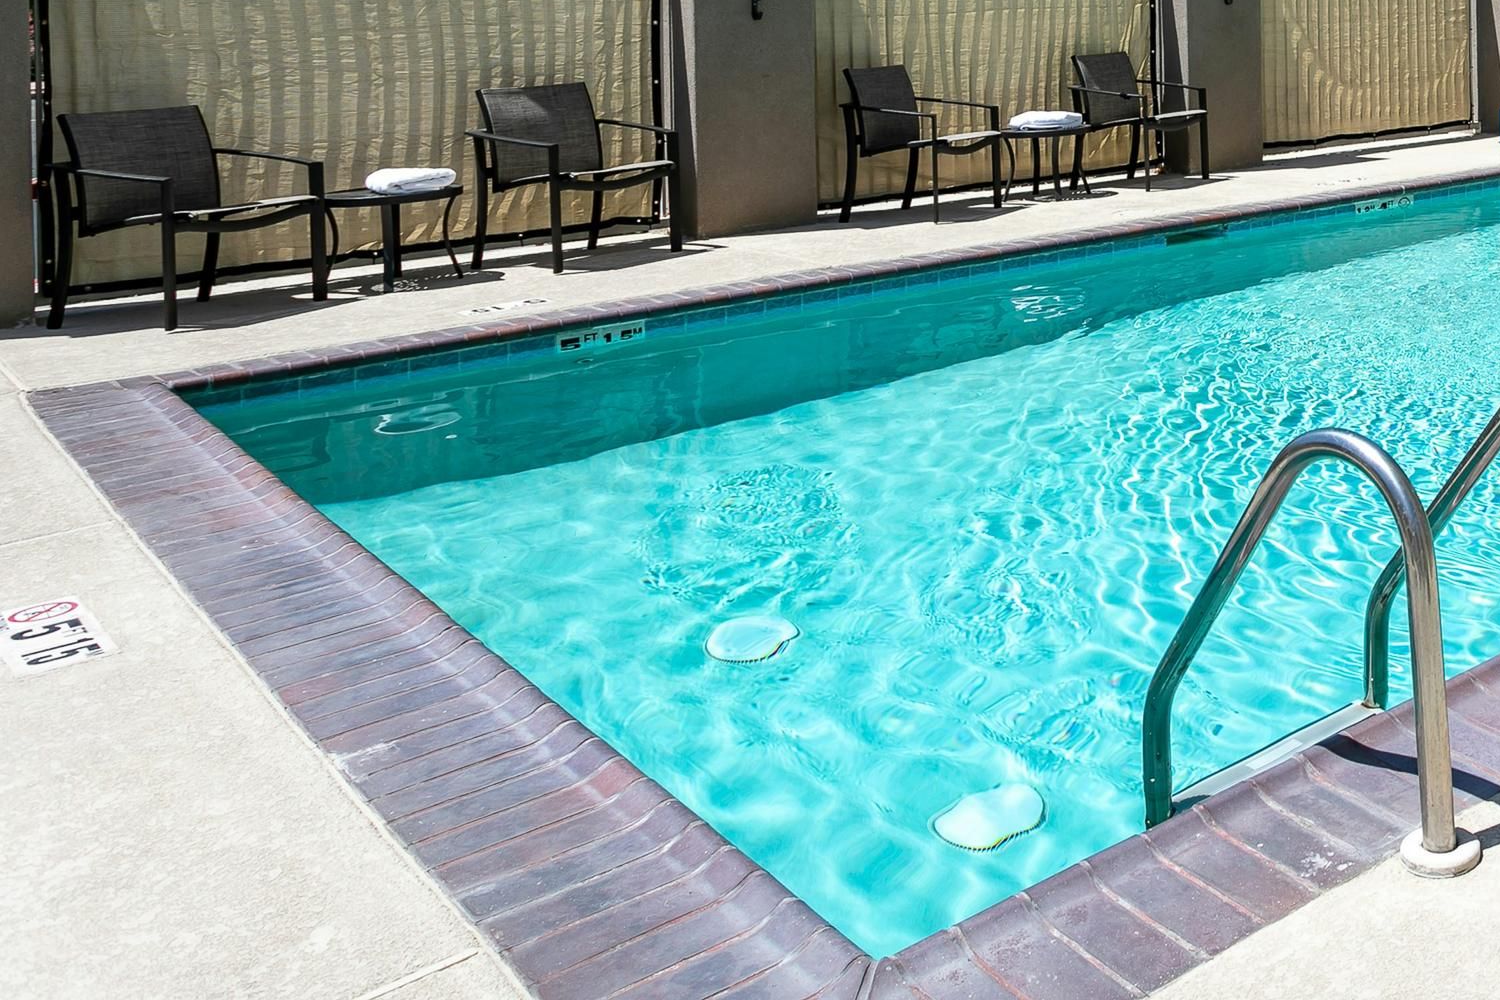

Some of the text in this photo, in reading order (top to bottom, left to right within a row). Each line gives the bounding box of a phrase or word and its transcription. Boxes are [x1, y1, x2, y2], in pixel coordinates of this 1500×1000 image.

[560, 337, 582, 351] 5
[583, 332, 598, 343] FT
[10, 617, 83, 641] 5
